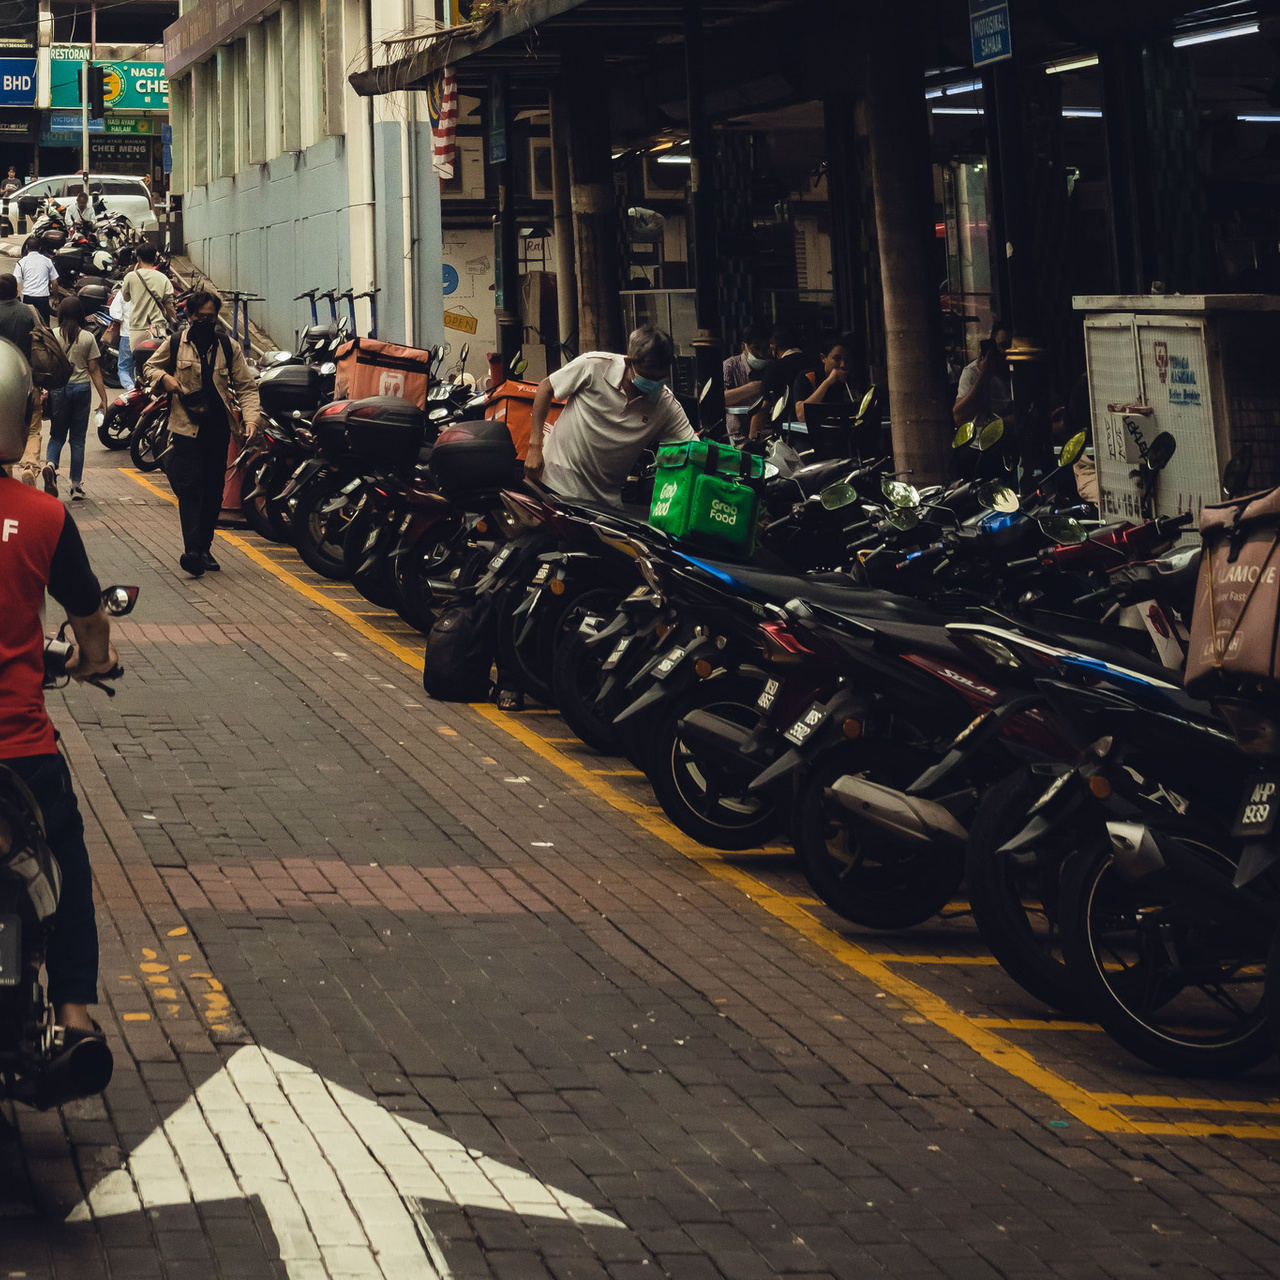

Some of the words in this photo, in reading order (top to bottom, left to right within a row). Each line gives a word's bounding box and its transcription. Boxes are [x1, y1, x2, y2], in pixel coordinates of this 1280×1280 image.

[973, 13, 1006, 38] MOTOSIKAL
[980, 32, 1003, 56] SAHAJA
[50, 48, 90, 60] RESTORAN
[130, 68, 157, 77] NASI
[3, 75, 31, 91] BHD
[42, 131, 75, 141] HOTEL
[91, 144, 116, 152] CHEE
[119, 145, 147, 153] MENG
[443, 312, 474, 331] OPEN
[522, 385, 537, 393] LALA
[711, 499, 738, 515] Grab
[710, 510, 737, 526] Food
[1250, 781, 1277, 804] AHP
[1241, 803, 1270, 825] 1939
